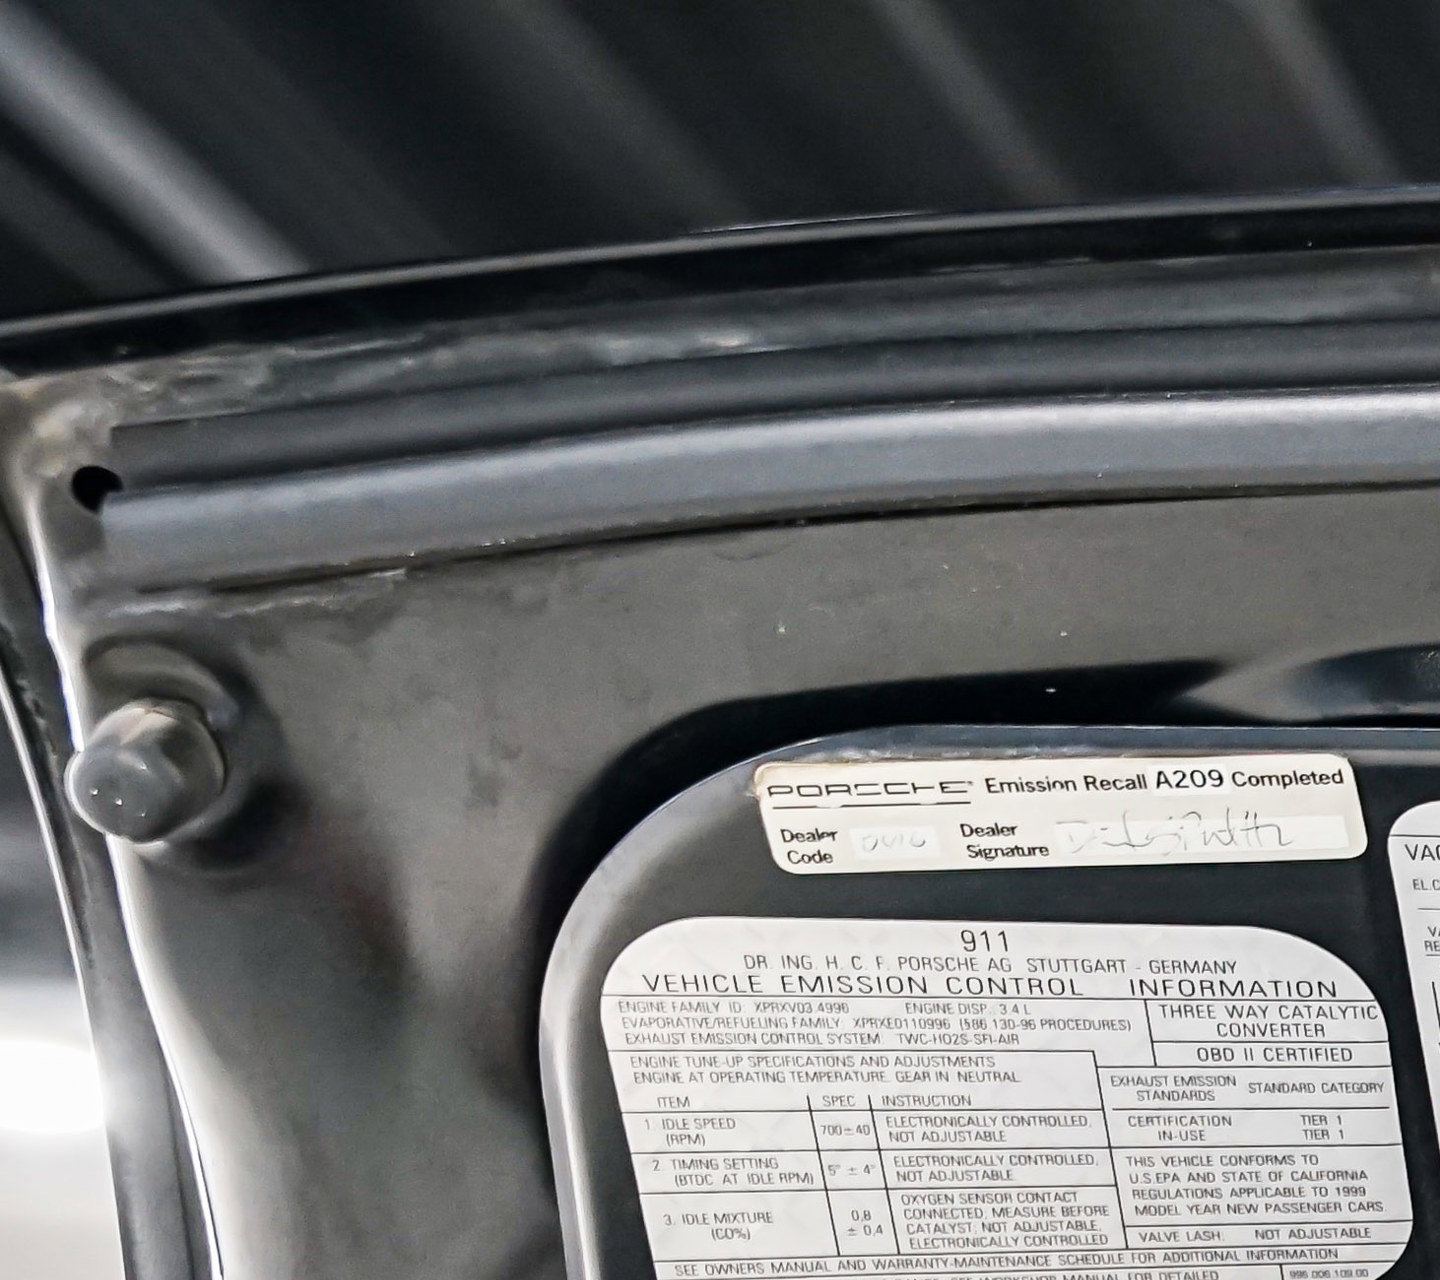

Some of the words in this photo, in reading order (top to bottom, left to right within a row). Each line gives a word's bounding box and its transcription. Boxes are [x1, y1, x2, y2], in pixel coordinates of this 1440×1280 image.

[767, 782, 968, 796] PORSCHE
[986, 776, 1078, 794] Emission
[1084, 773, 1148, 792] Recall
[1156, 769, 1224, 789] A209
[1232, 769, 1344, 792] Completed
[780, 828, 838, 844] Dealer
[960, 822, 1018, 838] Dealer
[787, 849, 834, 866] Code
[967, 842, 1050, 860] Signature
[960, 930, 1009, 952] 911
[898, 957, 980, 971] PORSCHE
[988, 958, 1012, 972] AG
[1027, 959, 1127, 974] STUTTGART
[1149, 960, 1236, 975] GERMANY
[643, 974, 763, 993] VEHICLE
[781, 975, 928, 995] EMISSION
[947, 976, 1084, 996] CONTROL
[1130, 979, 1337, 998] INFORMATION
[1158, 1004, 1217, 1019] THREE
[1225, 1005, 1269, 1019] WAY
[1279, 1005, 1378, 1020] CATALYTIC
[1217, 1024, 1325, 1038] CONVERTER
[1197, 1047, 1234, 1062] OBD
[1263, 1048, 1353, 1062] CERTIFIED
[1110, 1076, 1169, 1087] EXHAUST
[1173, 1076, 1236, 1087] EMISSION
[1248, 1082, 1315, 1094] STANDARD
[1321, 1082, 1385, 1093] CATEGORY
[657, 1097, 690, 1108] ITEM
[822, 1095, 856, 1107] SPEC
[882, 1095, 972, 1106] INSTRUCTION
[1136, 1090, 1216, 1101] STANDARDS
[1128, 1115, 1232, 1127] CERTIFICATION
[1301, 1115, 1328, 1126] TIER
[1337, 1115, 1343, 1126] 1
[1158, 1130, 1205, 1142] IN-USE
[1302, 1129, 1330, 1140] TIER
[1339, 1129, 1344, 1140] 1
[1126, 1156, 1155, 1167] THIS
[1161, 1156, 1214, 1167] VEHICLE
[1220, 1155, 1296, 1166] CONFORMS
[1301, 1155, 1319, 1165] TO
[1187, 1171, 1216, 1183] AND
[1222, 1171, 1262, 1182] STATE
[1268, 1171, 1283, 1182] OF
[1290, 1171, 1368, 1181] CALIFORNIA
[1132, 1187, 1223, 1200] REGULATIONS
[1230, 1187, 1306, 1198] APPLICABLE
[1311, 1187, 1329, 1197] TO
[1335, 1187, 1366, 1198] 1999
[1135, 1203, 1181, 1216] MODEL
[1186, 1203, 1220, 1214] YEAR
[1227, 1203, 1259, 1214] NEW
[1264, 1202, 1342, 1214] PASSENGER
[1138, 1231, 1180, 1243] VALVE
[1255, 1229, 1281, 1240] NOT
[1288, 1228, 1371, 1239] ADJUSTABLE
